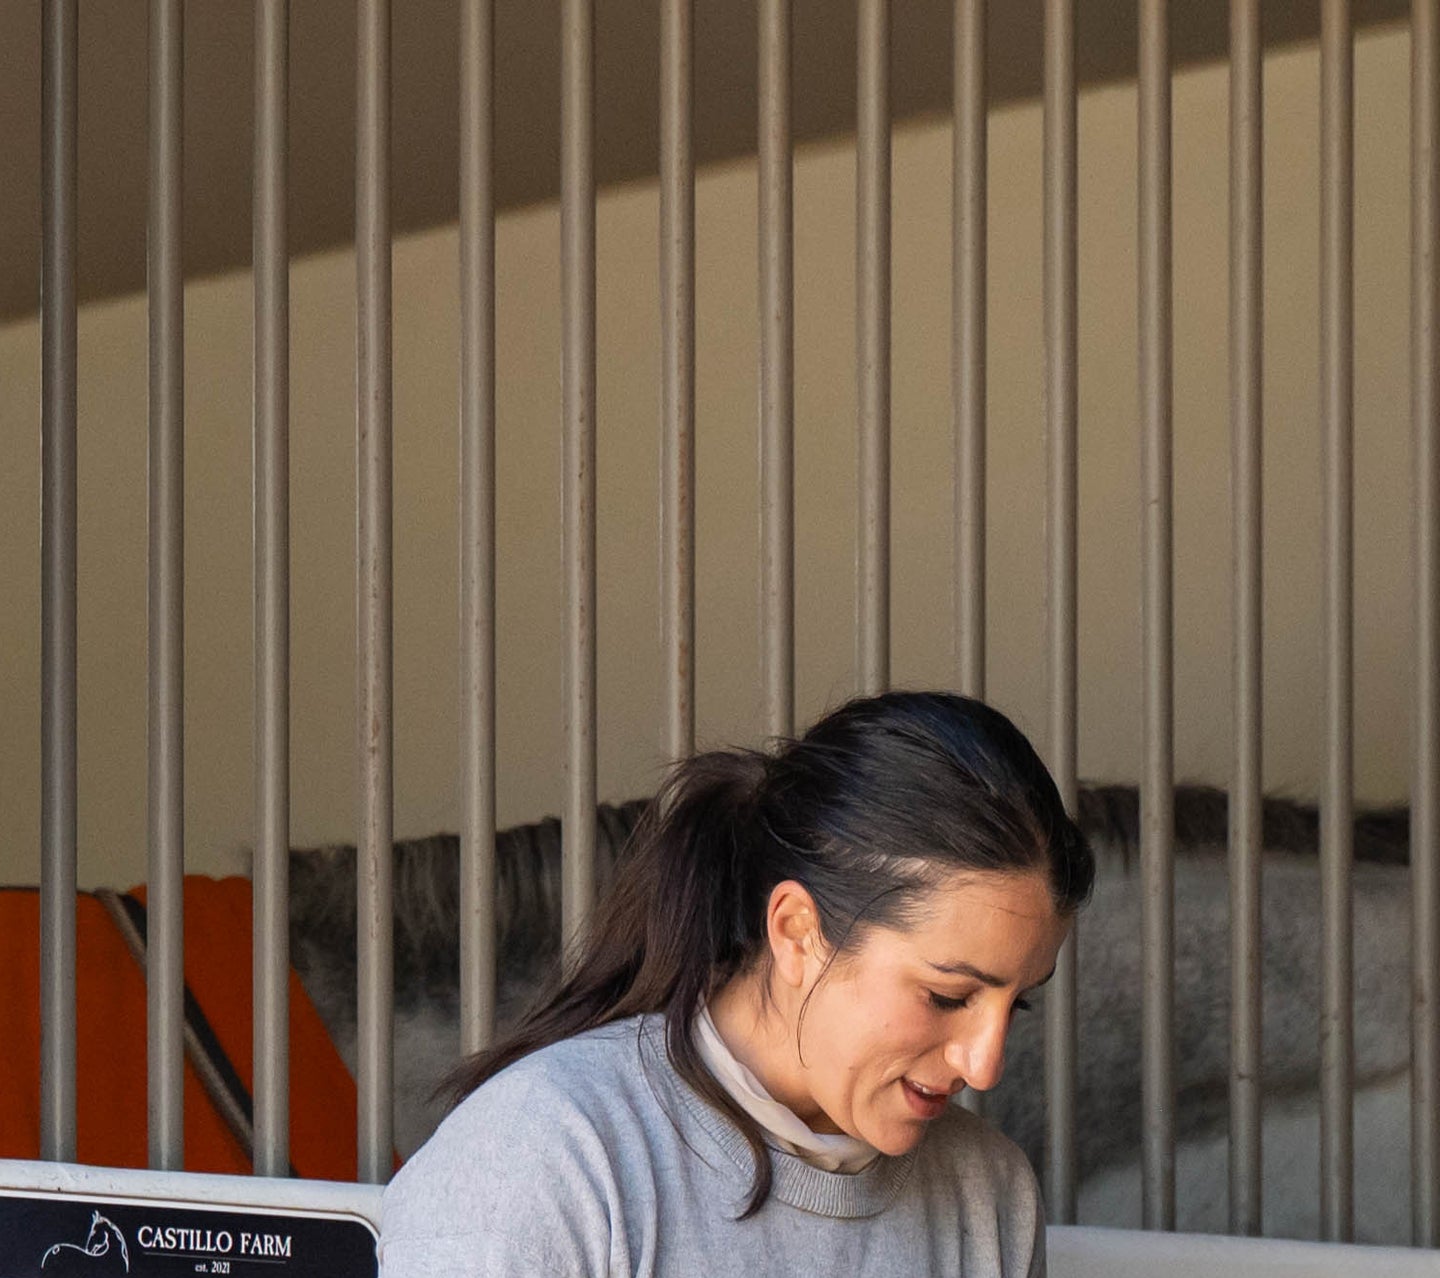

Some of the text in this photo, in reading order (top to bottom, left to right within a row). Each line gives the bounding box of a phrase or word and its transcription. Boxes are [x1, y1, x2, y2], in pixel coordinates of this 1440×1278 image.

[137, 1226, 293, 1258] CASTILLO FARM
[195, 1262, 230, 1275] est. 2021
